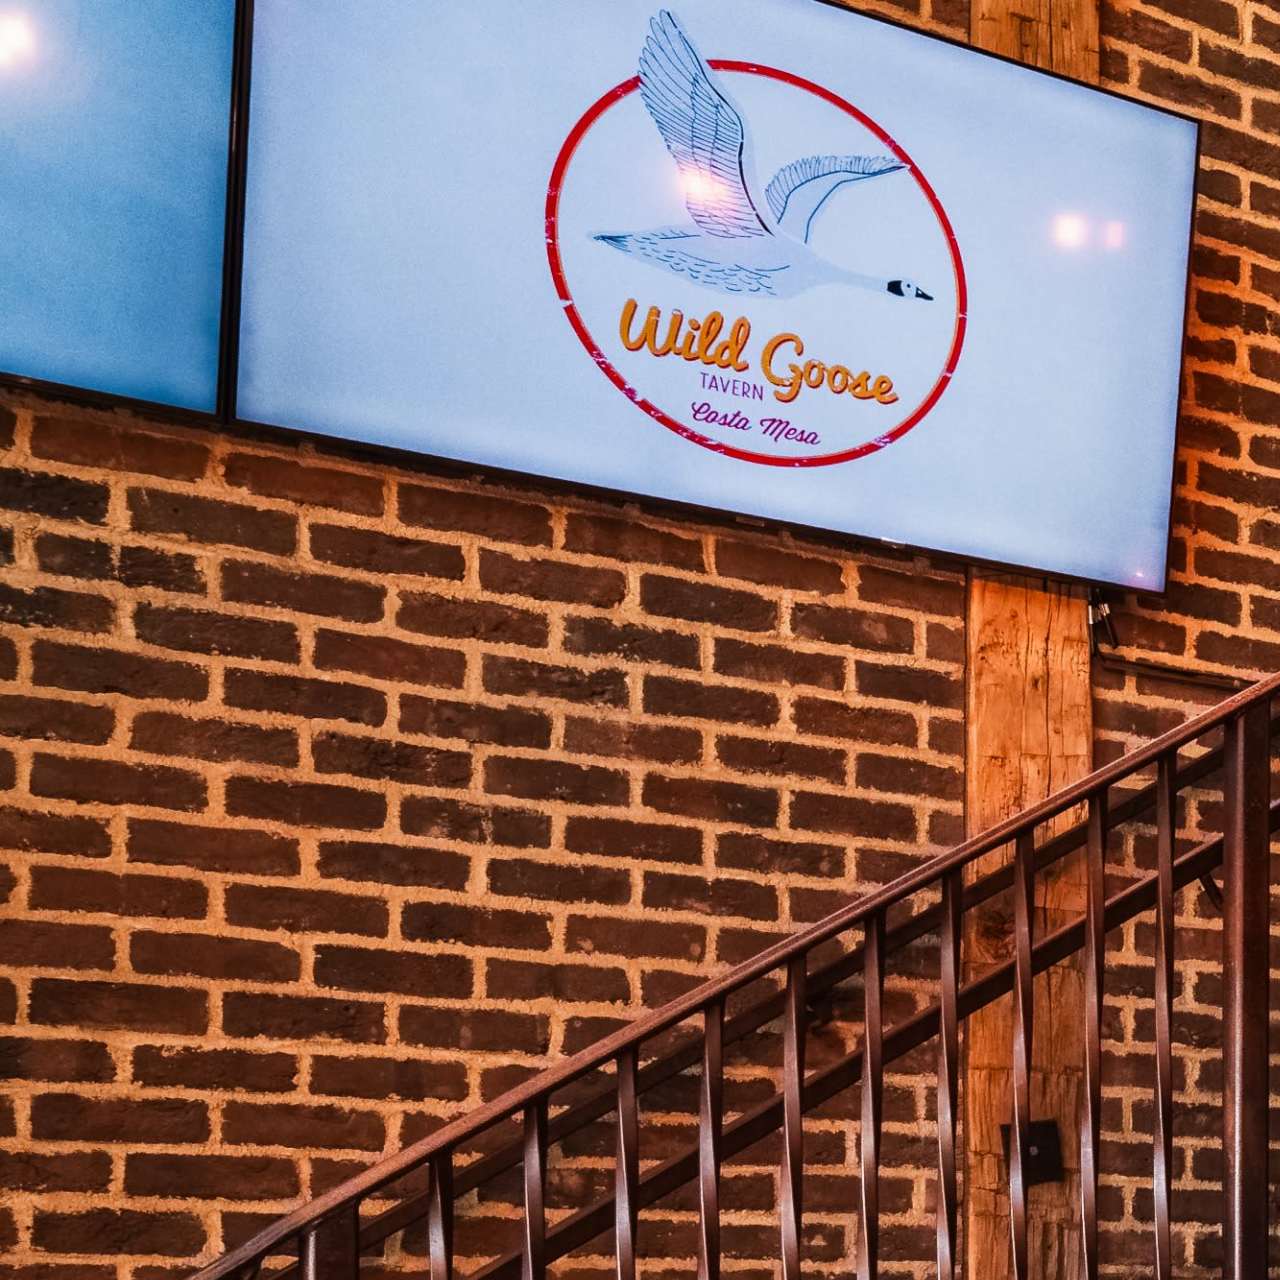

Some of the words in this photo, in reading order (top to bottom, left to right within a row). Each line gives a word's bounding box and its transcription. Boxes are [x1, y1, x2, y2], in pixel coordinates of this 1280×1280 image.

[619, 298, 751, 372] Wild
[760, 333, 899, 404] Goose
[700, 372, 764, 401] TAVERN
[691, 402, 752, 432] Costa
[759, 418, 820, 446] Mesa
